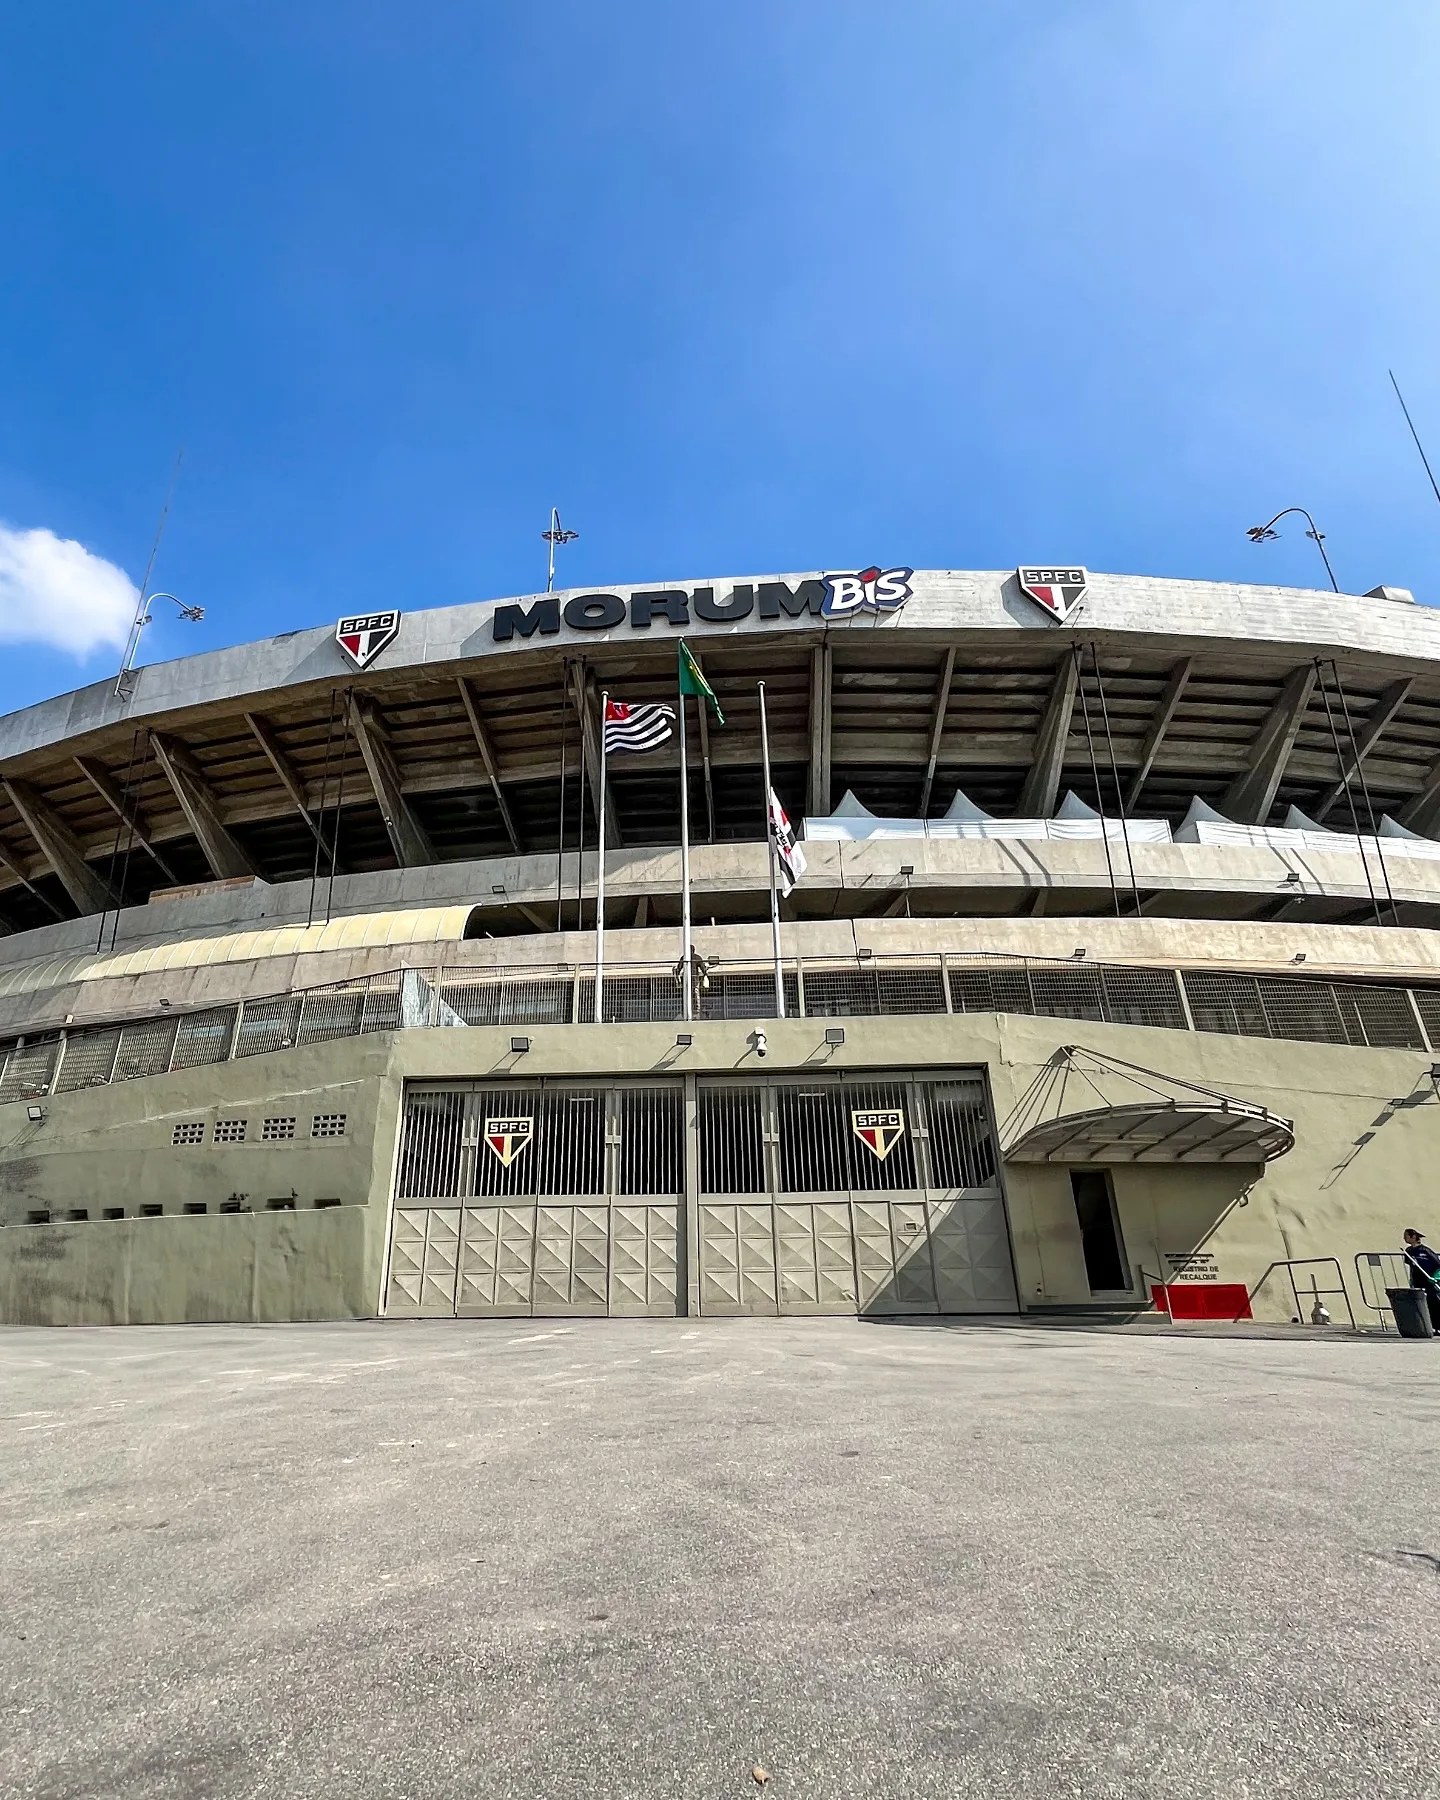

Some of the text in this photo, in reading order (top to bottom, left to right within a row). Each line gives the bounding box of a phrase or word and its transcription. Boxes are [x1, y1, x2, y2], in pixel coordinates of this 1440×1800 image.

[1026, 571, 1082, 583] SPFC
[342, 615, 392, 633] SPFC
[857, 1114, 898, 1126] SPFC
[489, 1122, 528, 1133] SPFC
